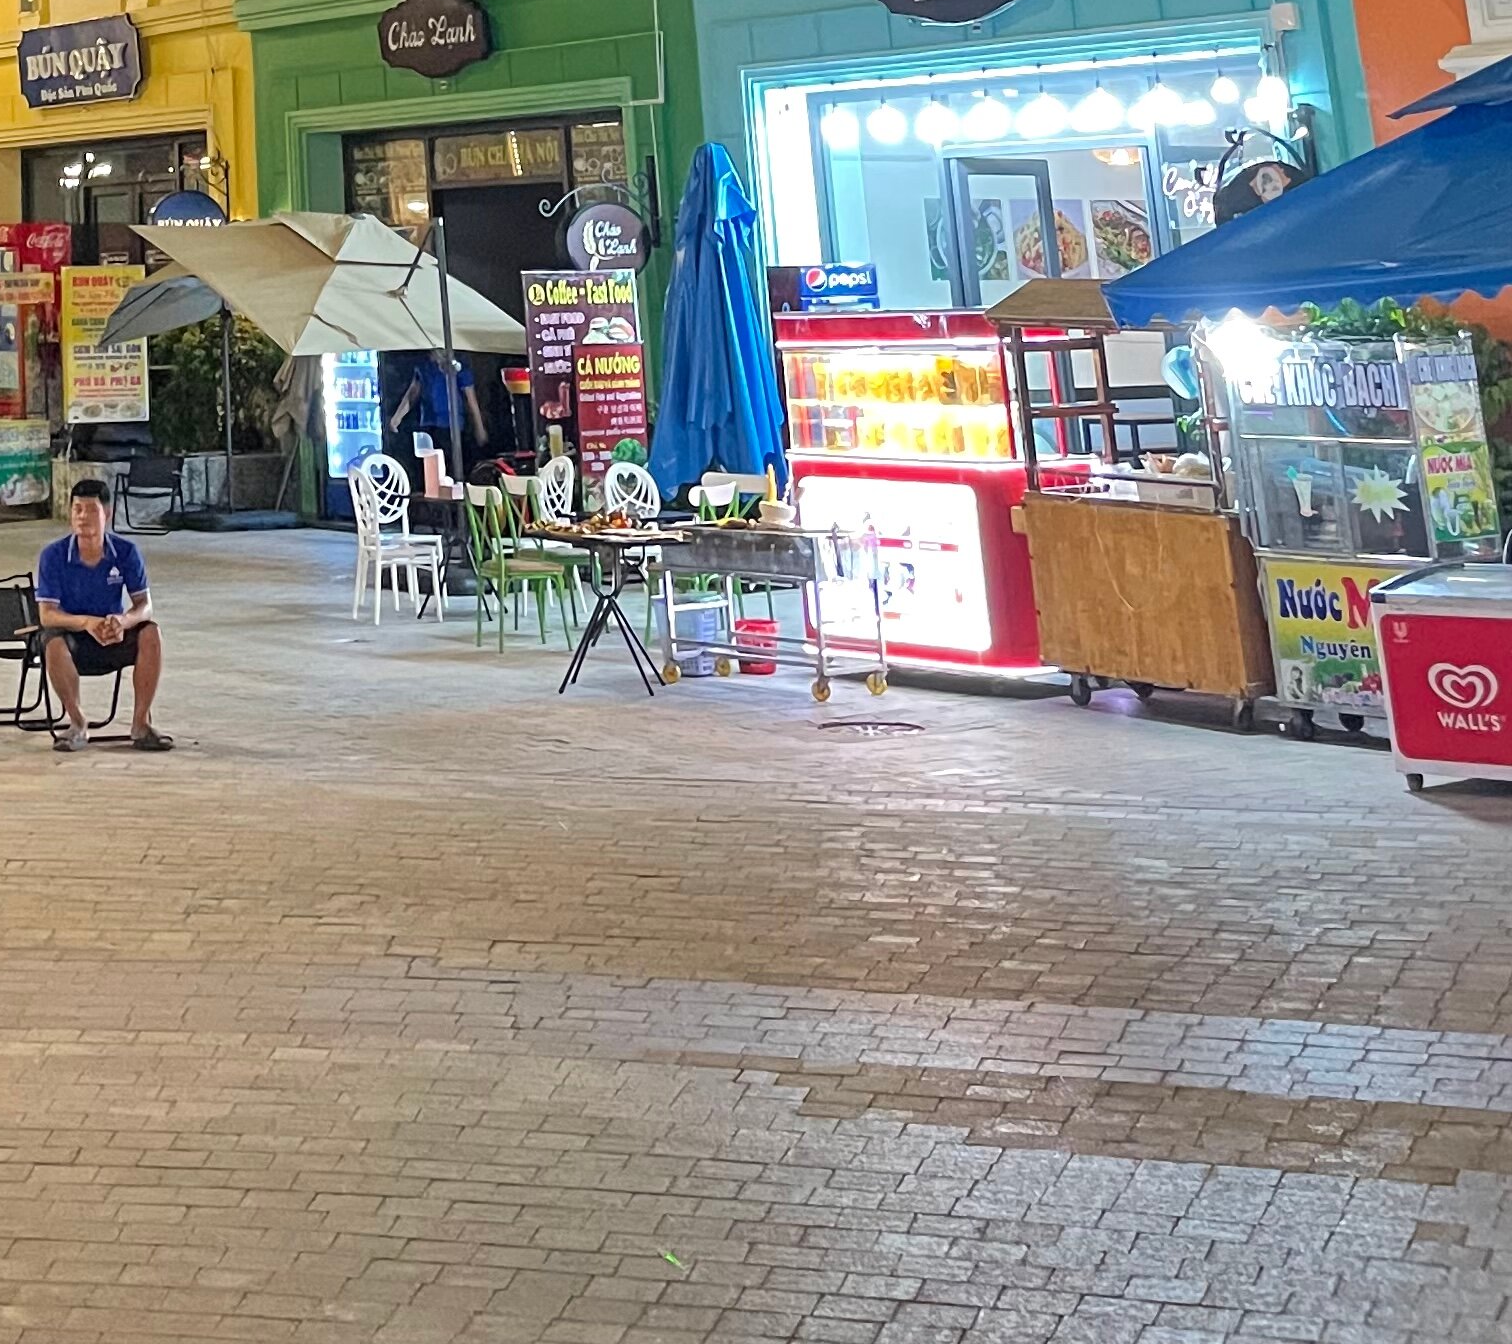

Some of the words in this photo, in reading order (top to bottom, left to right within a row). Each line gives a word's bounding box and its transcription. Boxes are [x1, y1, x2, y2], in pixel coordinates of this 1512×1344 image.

[388, 20, 425, 51] Cháo
[427, 13, 476, 50] Lạnh
[26, 45, 68, 82] BÚN
[68, 36, 129, 80] QUẬY
[460, 142, 486, 168] BÚN
[594, 220, 622, 238] Cháo
[605, 238, 637, 257] Lạnh
[546, 279, 578, 305] Coffee
[828, 270, 873, 289] pepsi
[577, 353, 594, 376] CÁ
[594, 351, 641, 376] NƯỚNG
[1282, 361, 1337, 407] KHÚC
[1276, 577, 1343, 623] Nước
[1299, 635, 1372, 661] Nguyên
[1436, 711, 1502, 732] WALL'S
